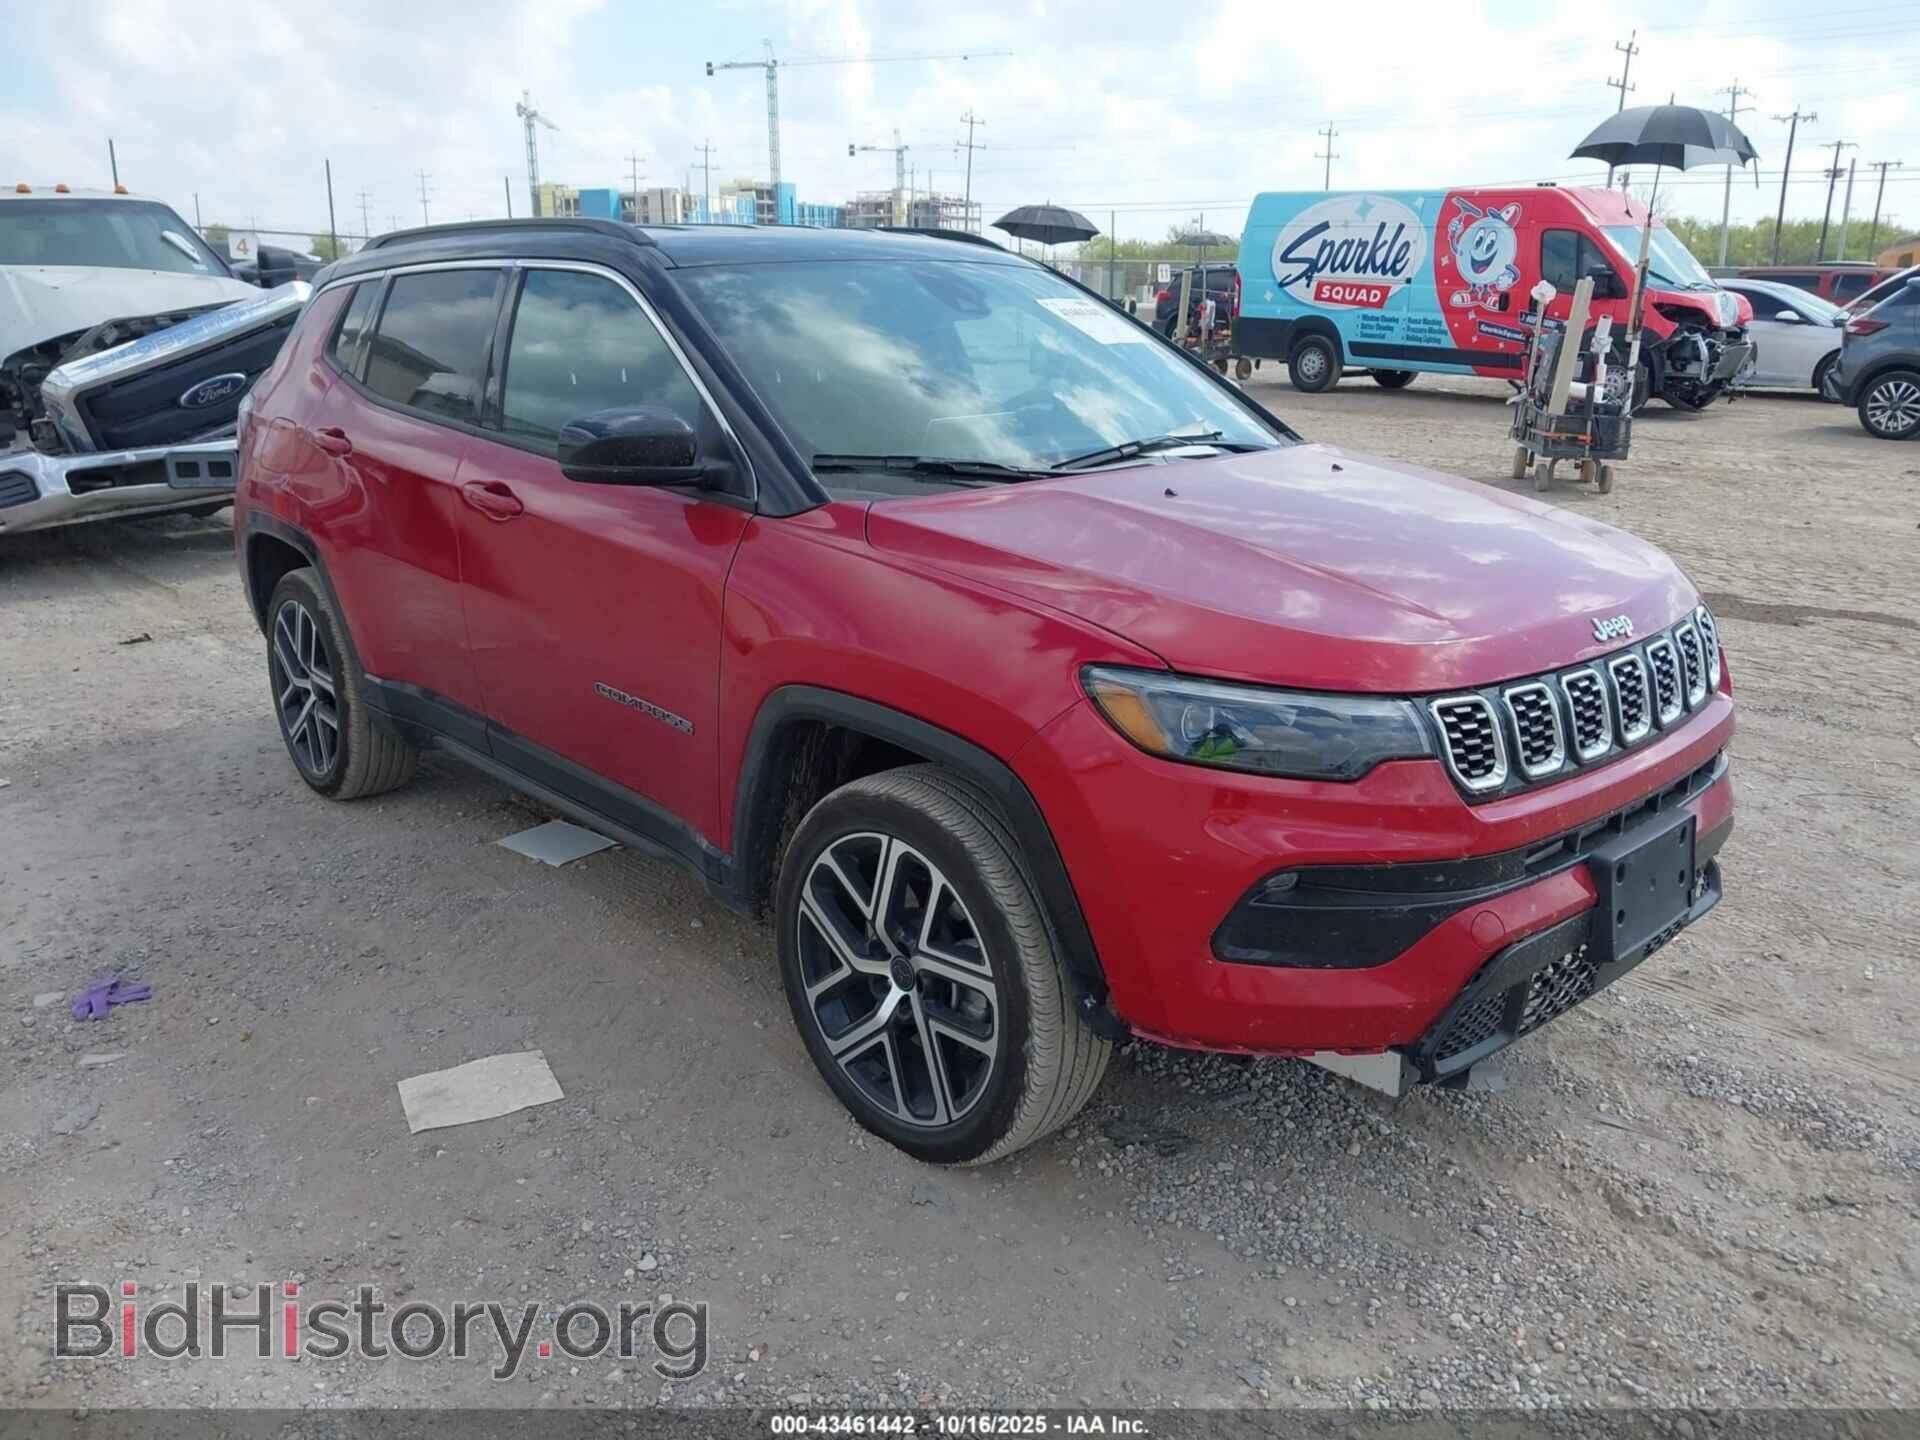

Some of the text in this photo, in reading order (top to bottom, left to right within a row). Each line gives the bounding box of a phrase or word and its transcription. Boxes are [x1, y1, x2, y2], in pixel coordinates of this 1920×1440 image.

[235, 238, 249, 255] 4
[1278, 220, 1411, 288] Sparkle
[1320, 285, 1382, 303] SQUAD
[198, 380, 232, 404] Ford
[1591, 614, 1634, 642] Jeep
[594, 682, 694, 736] COMPASS
